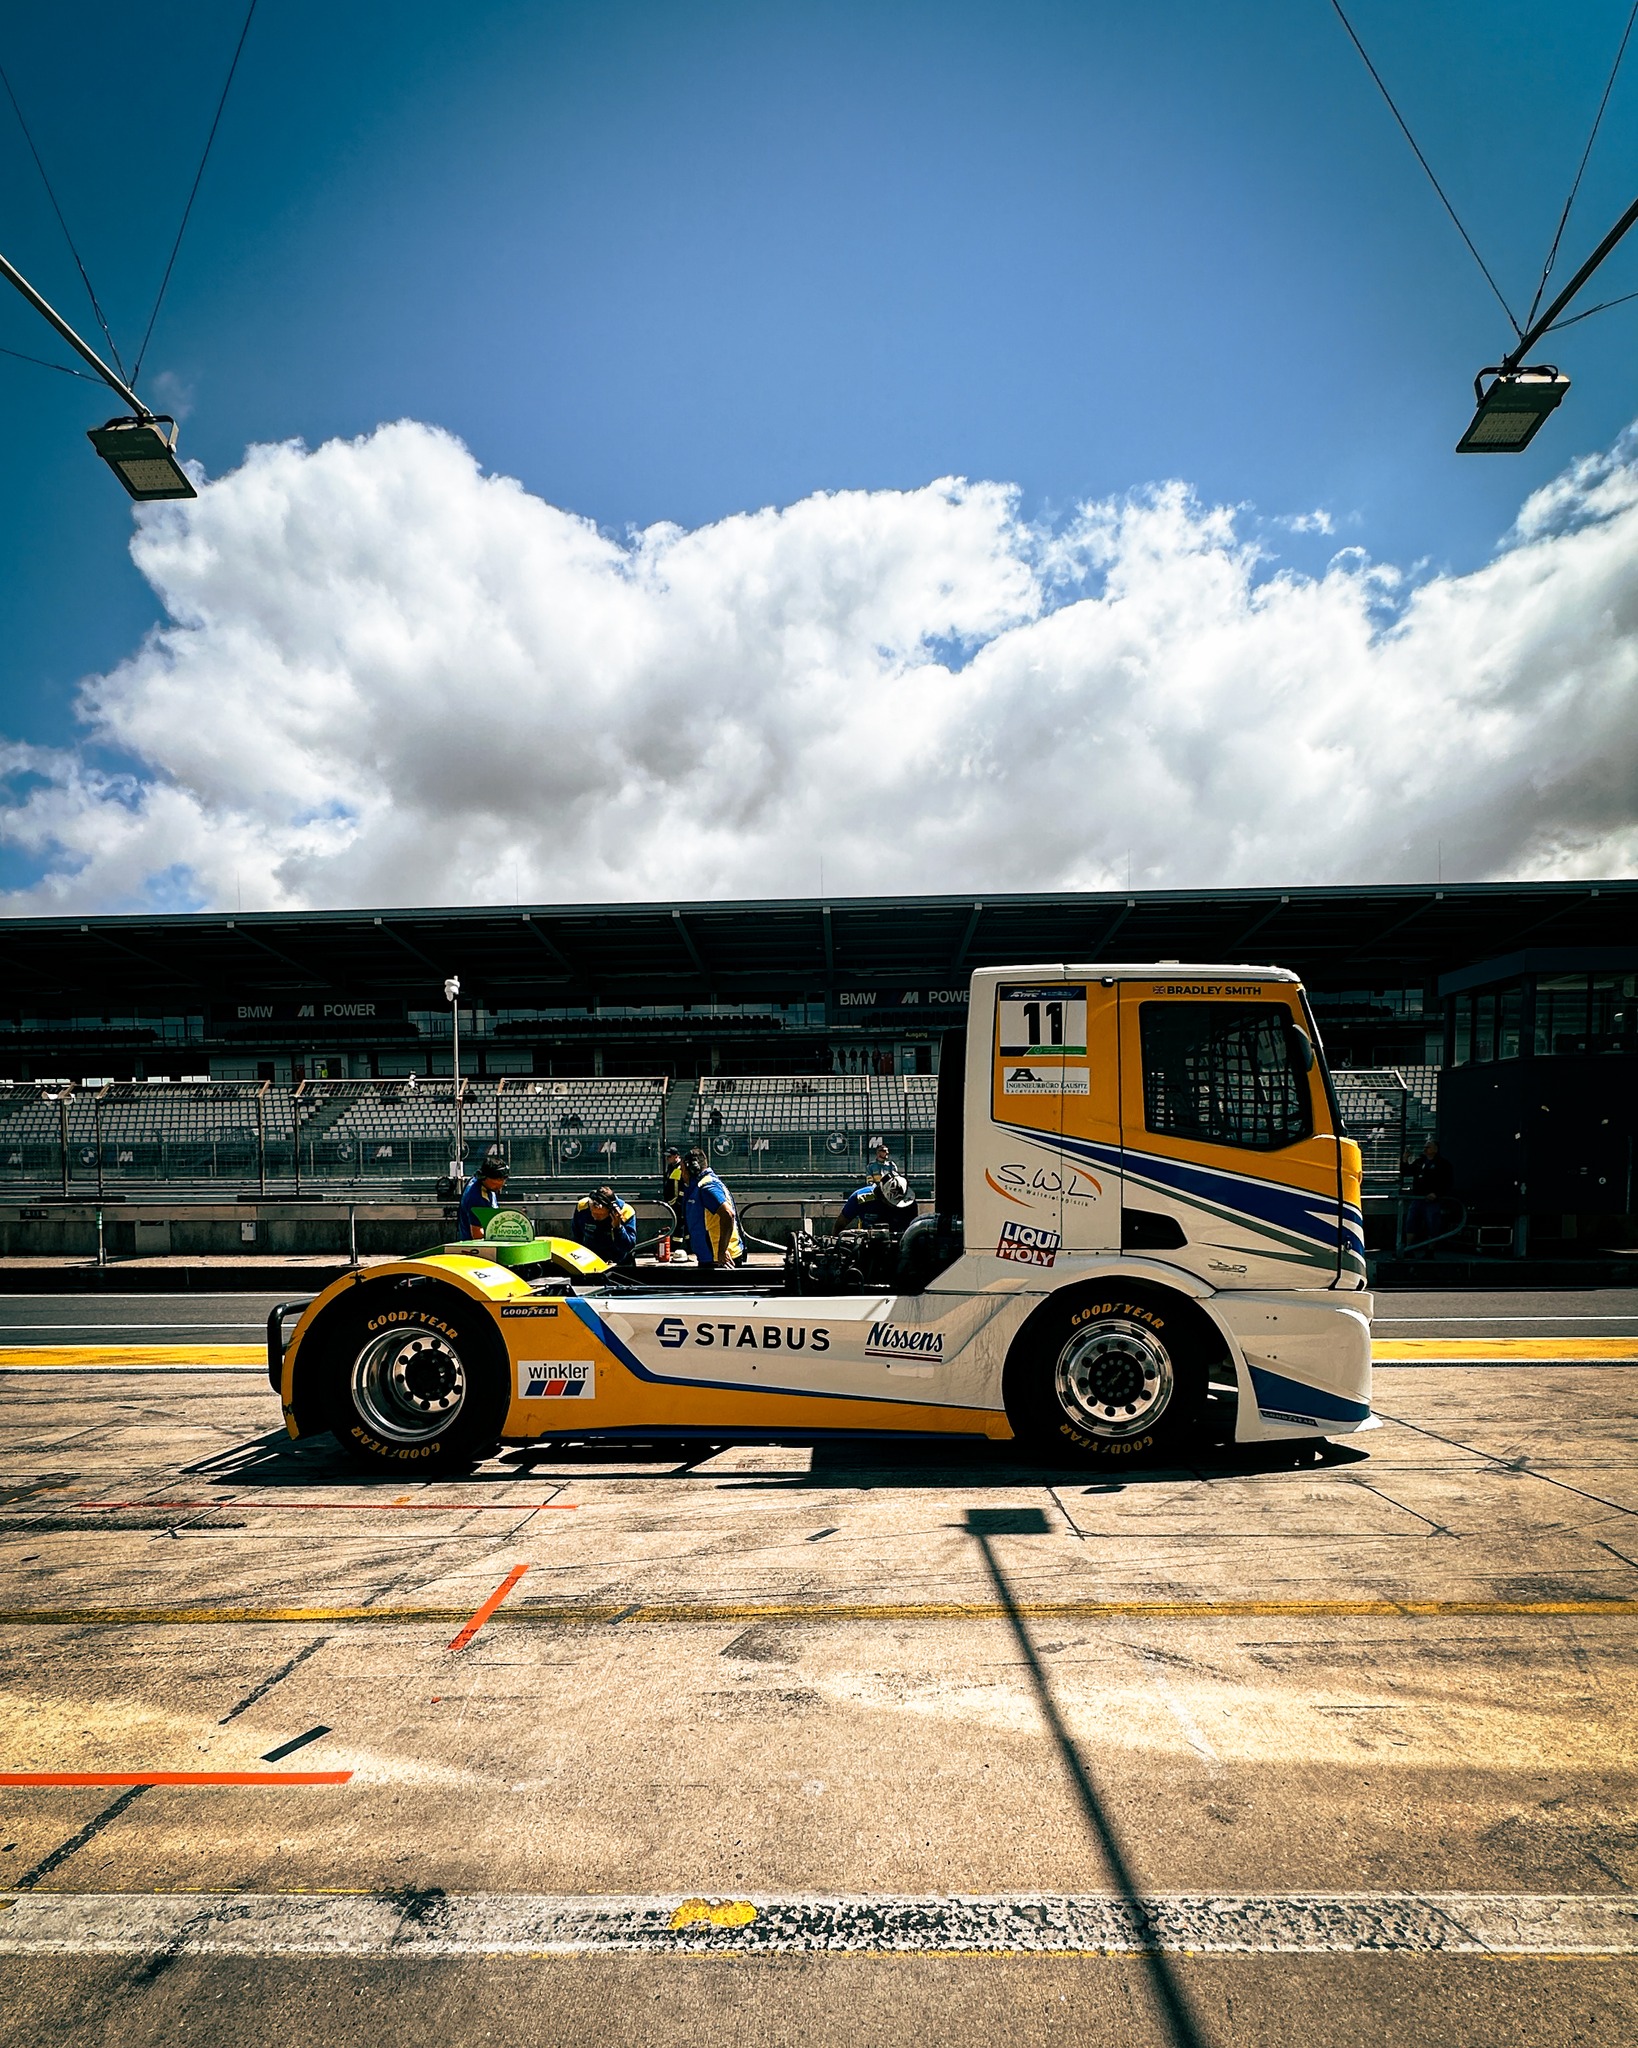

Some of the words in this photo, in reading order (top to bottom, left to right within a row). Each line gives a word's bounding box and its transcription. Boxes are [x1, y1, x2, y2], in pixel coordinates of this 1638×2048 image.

[840, 992, 877, 1005] BMW
[928, 990, 970, 1003] POWE
[1167, 985, 1222, 995] BRADLEY
[1225, 986, 1261, 995] SMITH
[237, 1006, 273, 1018] BMW
[323, 1004, 376, 1016] POWER
[1023, 1002, 1063, 1045] 11
[1004, 1184, 1022, 1193] Sven
[1004, 1222, 1058, 1249] LIQUI
[999, 1240, 1054, 1266] MOLY
[502, 1306, 557, 1316] GOODYEAR
[1071, 1303, 1165, 1329] GOODYEAR
[367, 1311, 458, 1339] GOODYEAR
[695, 1322, 830, 1351] STABUS
[866, 1322, 944, 1352] Nissens
[528, 1363, 589, 1379] winkler
[350, 1426, 440, 1459] GOODYEAR
